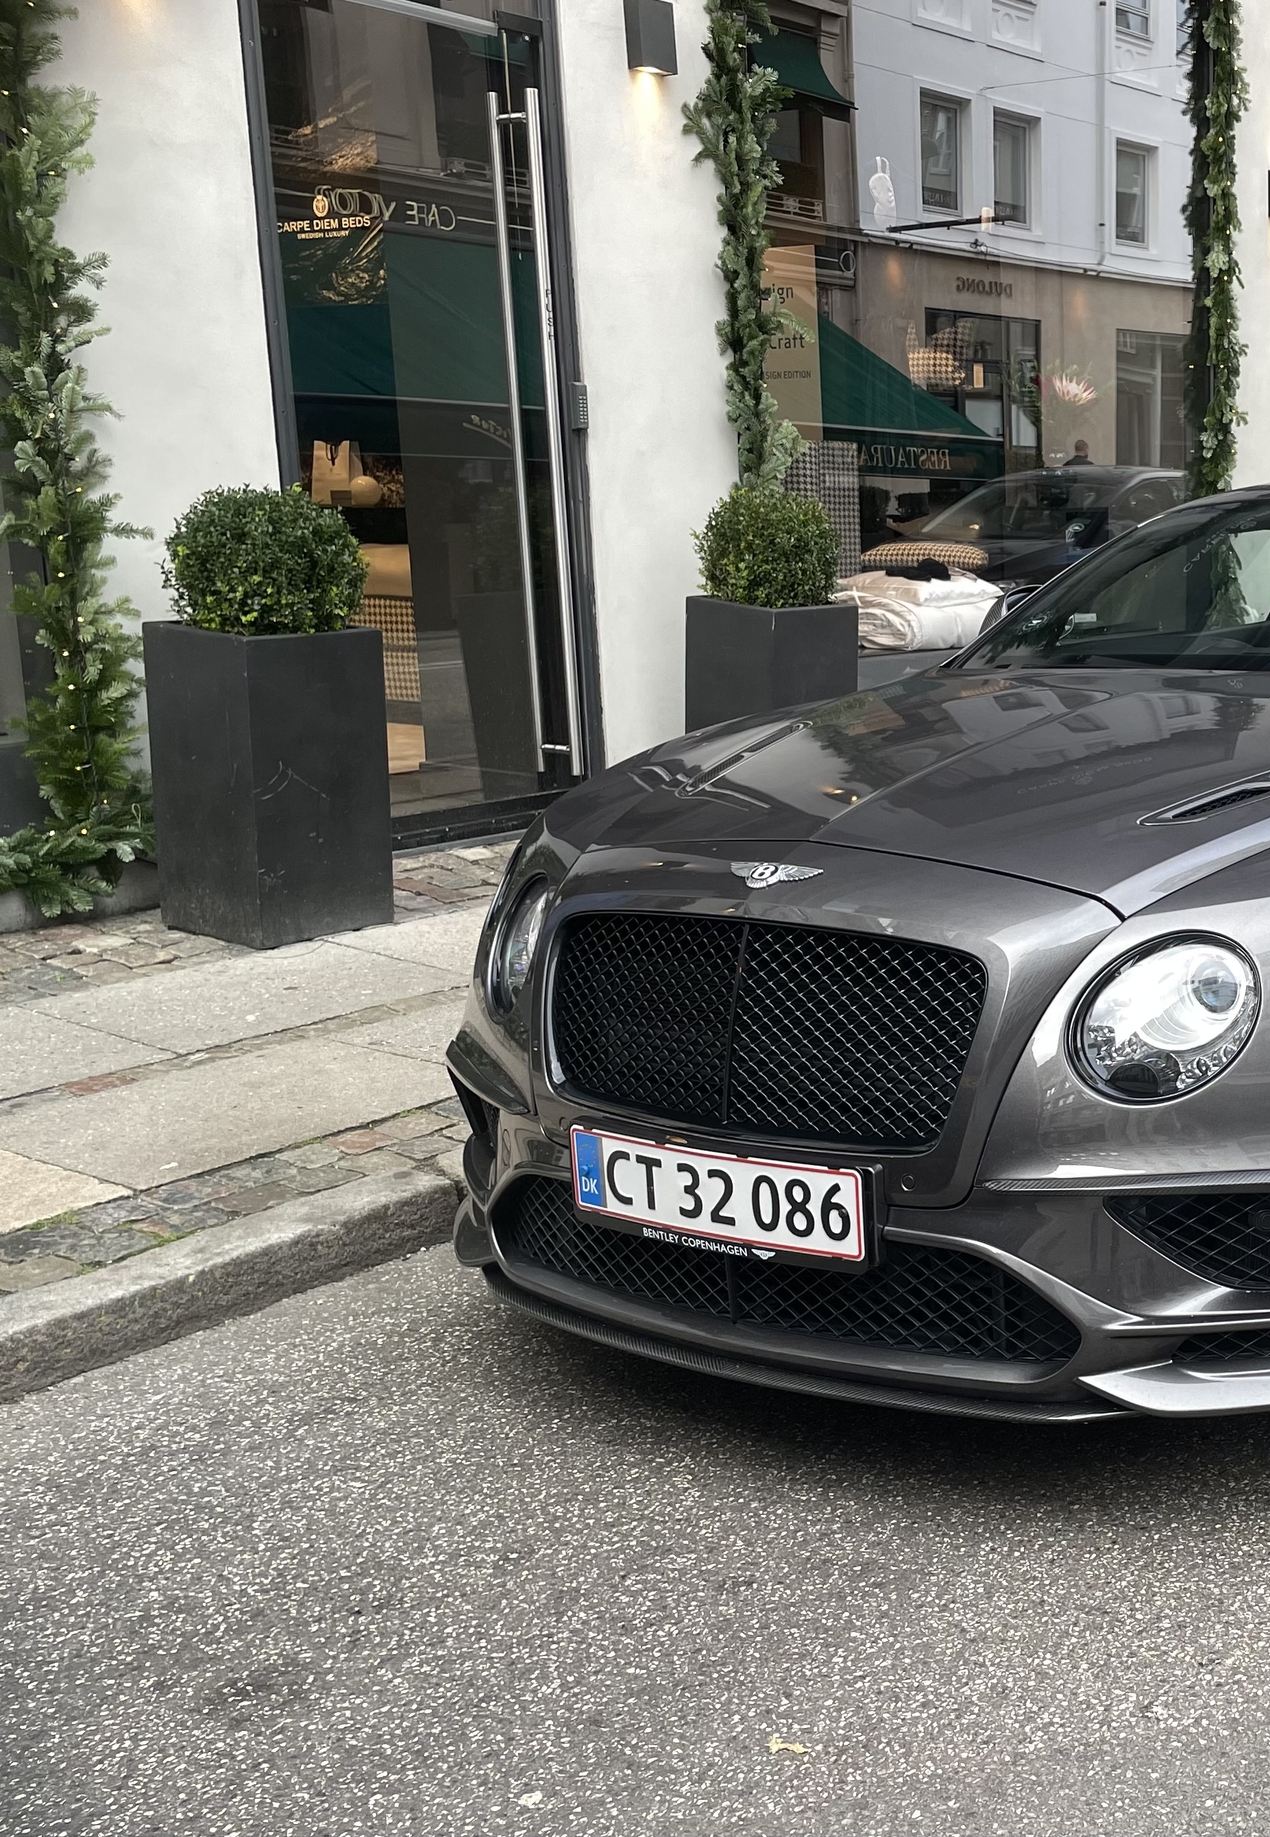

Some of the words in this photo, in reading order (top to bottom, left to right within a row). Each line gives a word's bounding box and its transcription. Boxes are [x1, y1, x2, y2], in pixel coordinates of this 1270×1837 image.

[313, 218, 339, 230] DIEM
[341, 216, 371, 228] BEDS
[297, 232, 324, 240] SWEDISH
[325, 230, 350, 238] LUXURY
[783, 370, 812, 380] EDITION
[581, 1176, 599, 1195] DK
[606, 1150, 662, 1211] CT
[676, 1162, 736, 1227] 32
[751, 1174, 851, 1241] 086
[642, 1227, 679, 1243] BENTLEY
[681, 1236, 748, 1257] COPENHAGEN
